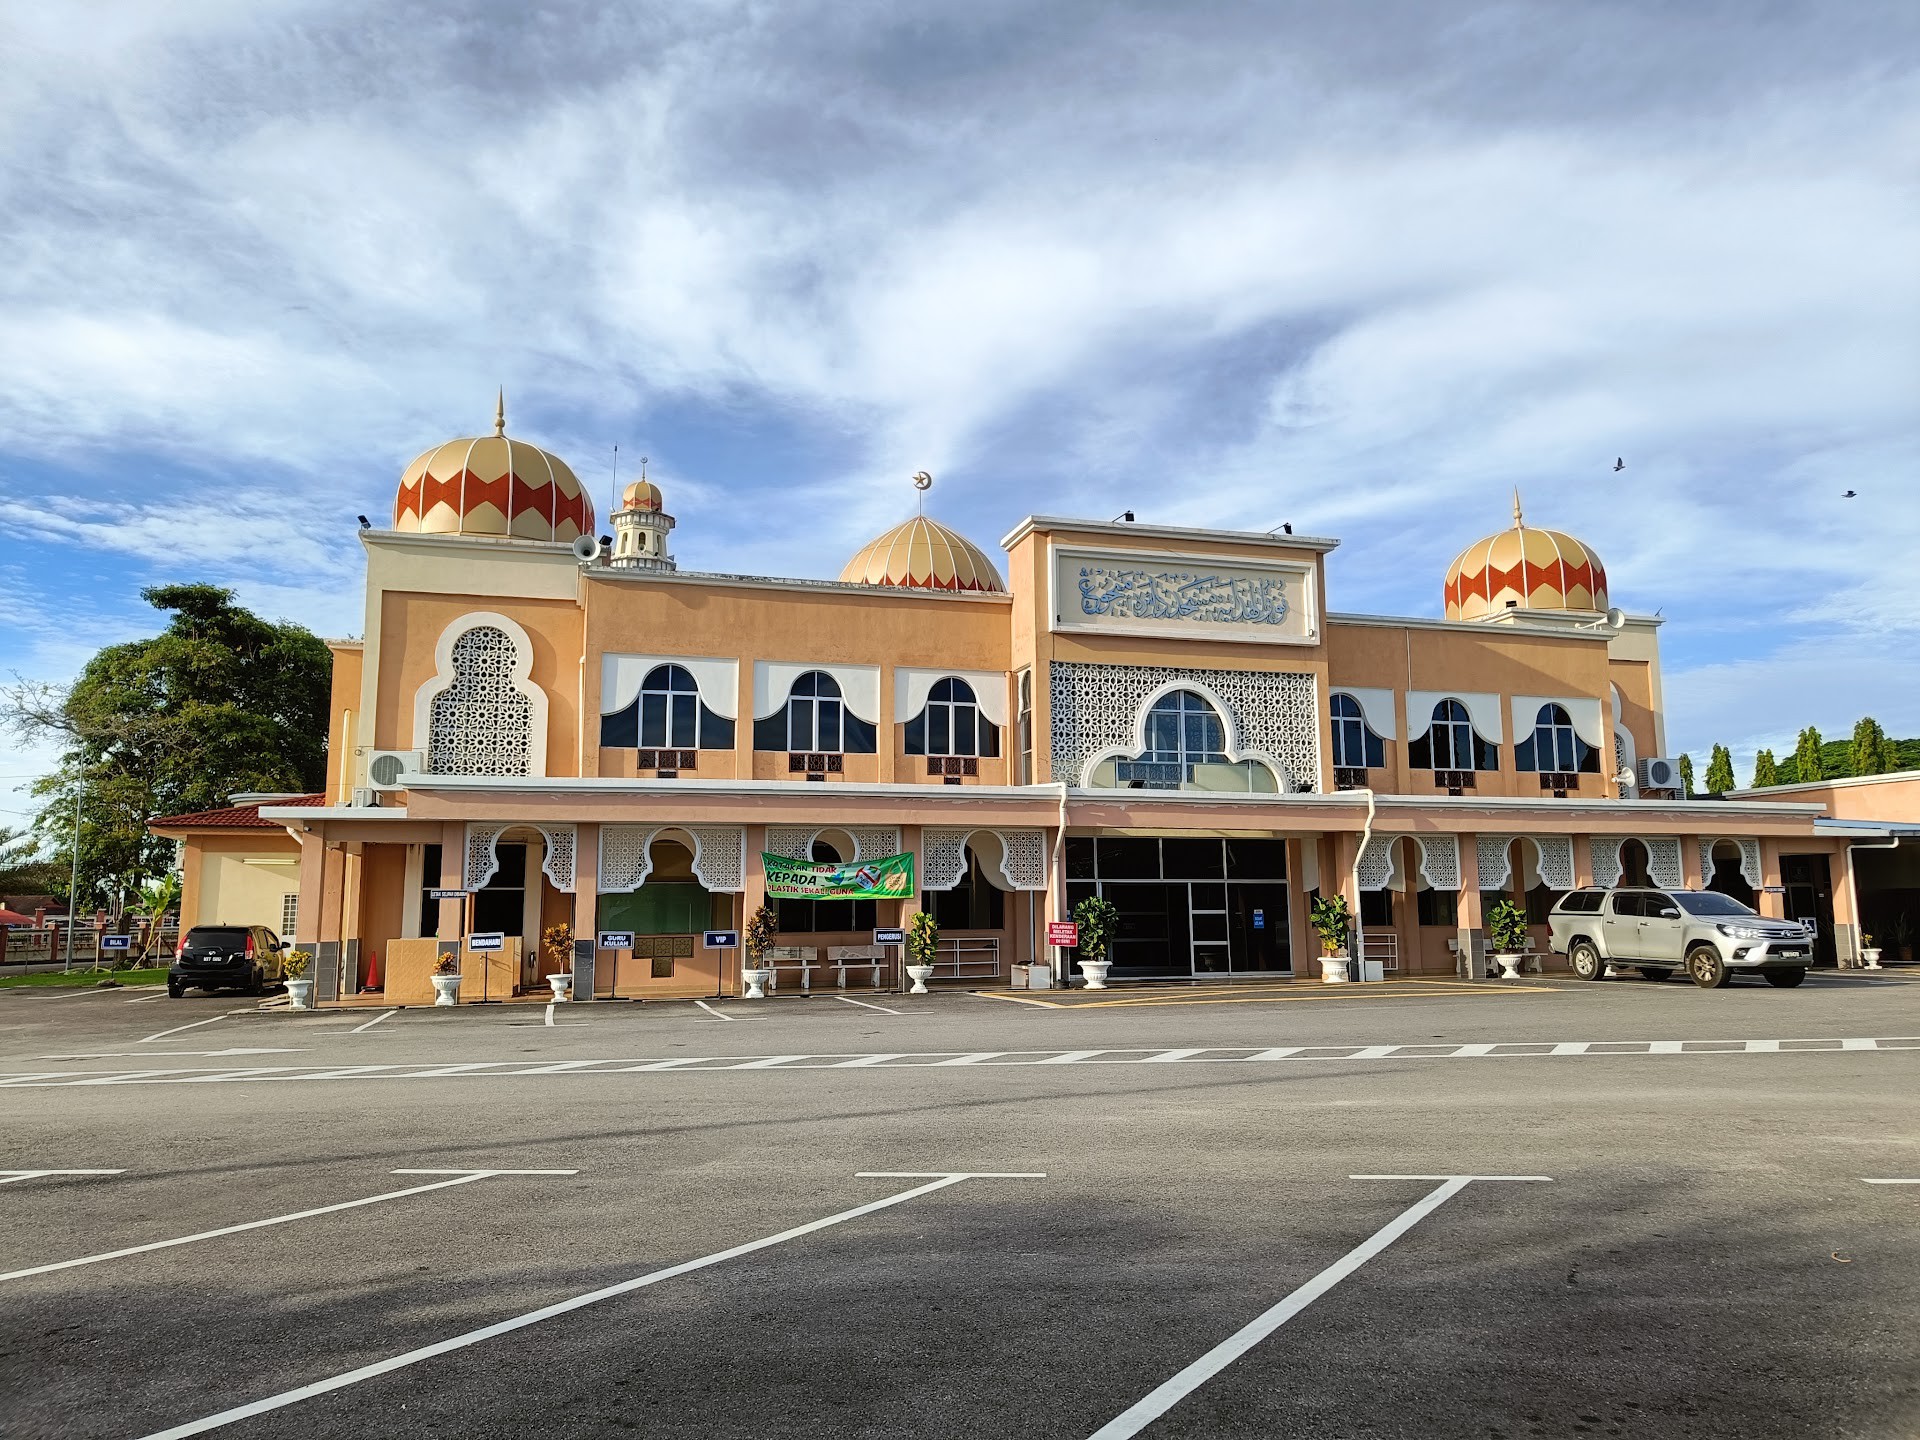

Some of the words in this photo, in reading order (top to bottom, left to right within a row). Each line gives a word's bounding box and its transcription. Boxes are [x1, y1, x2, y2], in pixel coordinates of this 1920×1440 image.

[767, 860, 808, 872] KATAKAN
[766, 871, 817, 886] KEPADA
[767, 885, 799, 893] PLASTIK
[801, 887, 828, 895] SEKALI
[878, 932, 902, 941] PENGERUSI
[471, 938, 501, 947] BENDAHARI
